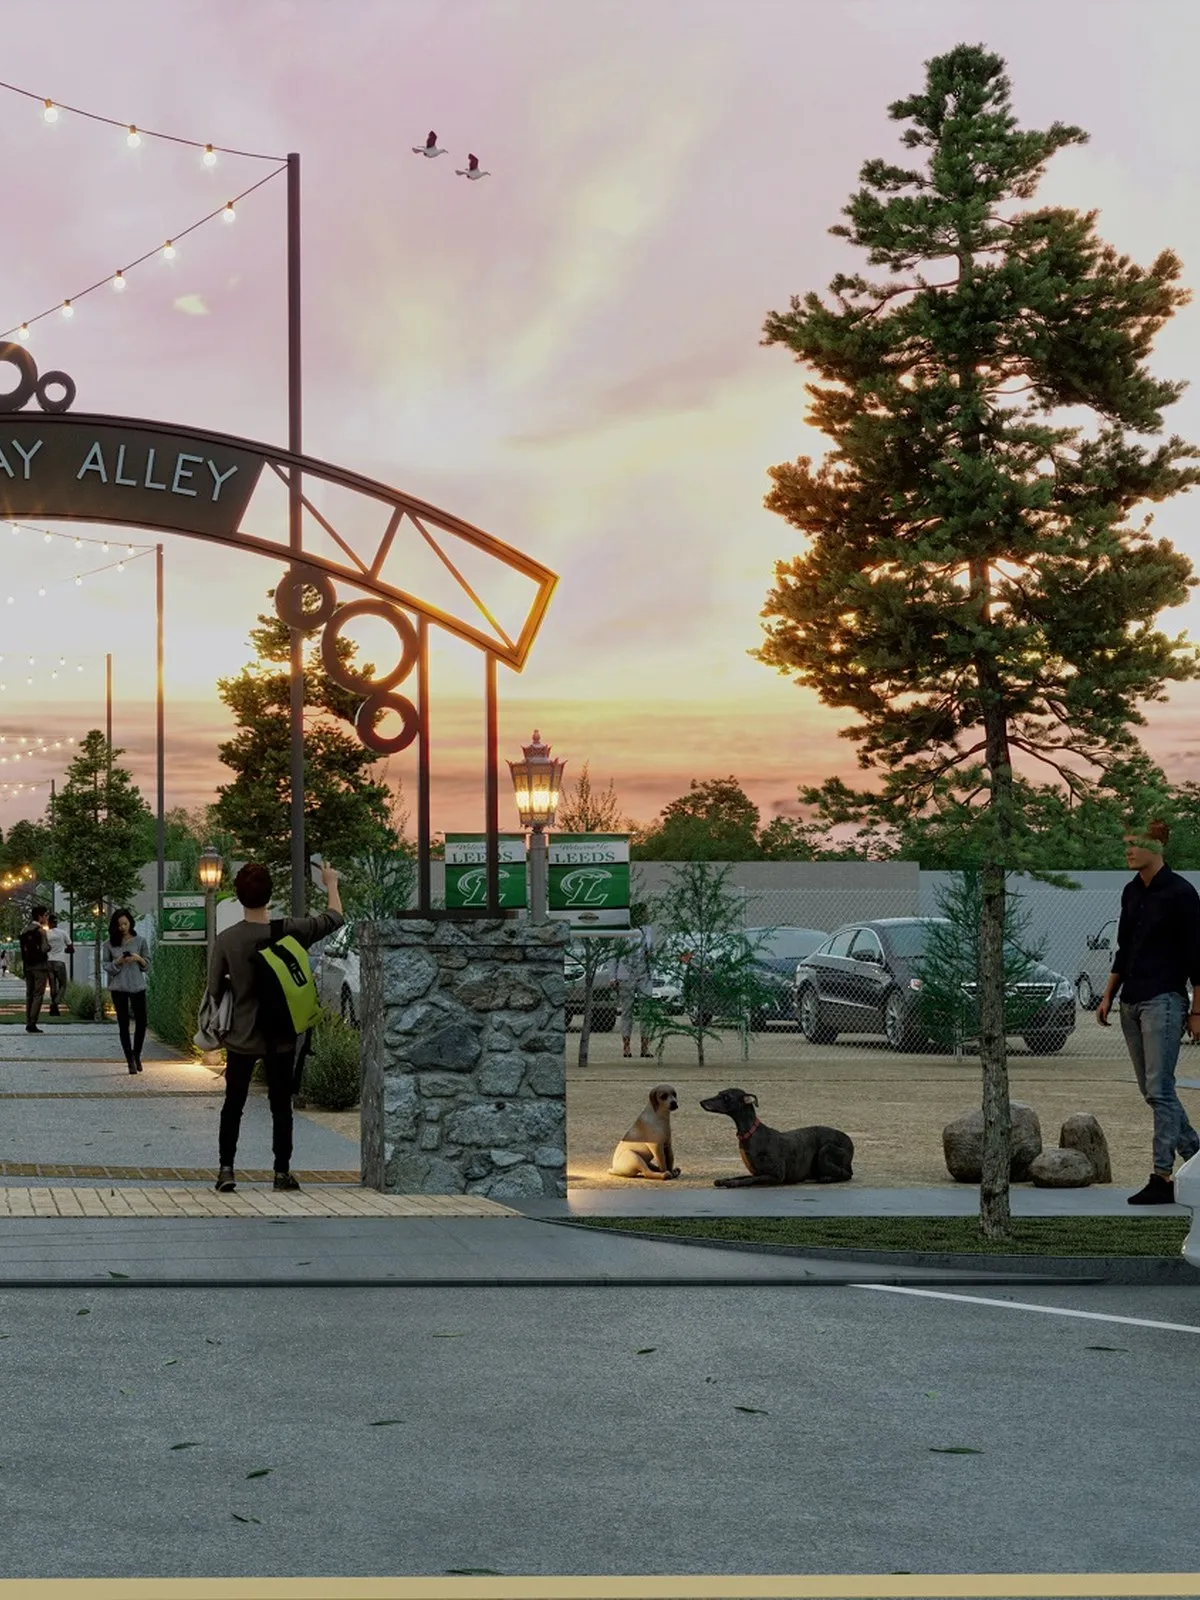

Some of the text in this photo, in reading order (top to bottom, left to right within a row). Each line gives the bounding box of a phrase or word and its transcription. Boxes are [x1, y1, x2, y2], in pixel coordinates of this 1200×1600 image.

[76, 441, 238, 502] ALLEY
[452, 850, 513, 863] LEES
[555, 851, 616, 863] LEEDS
